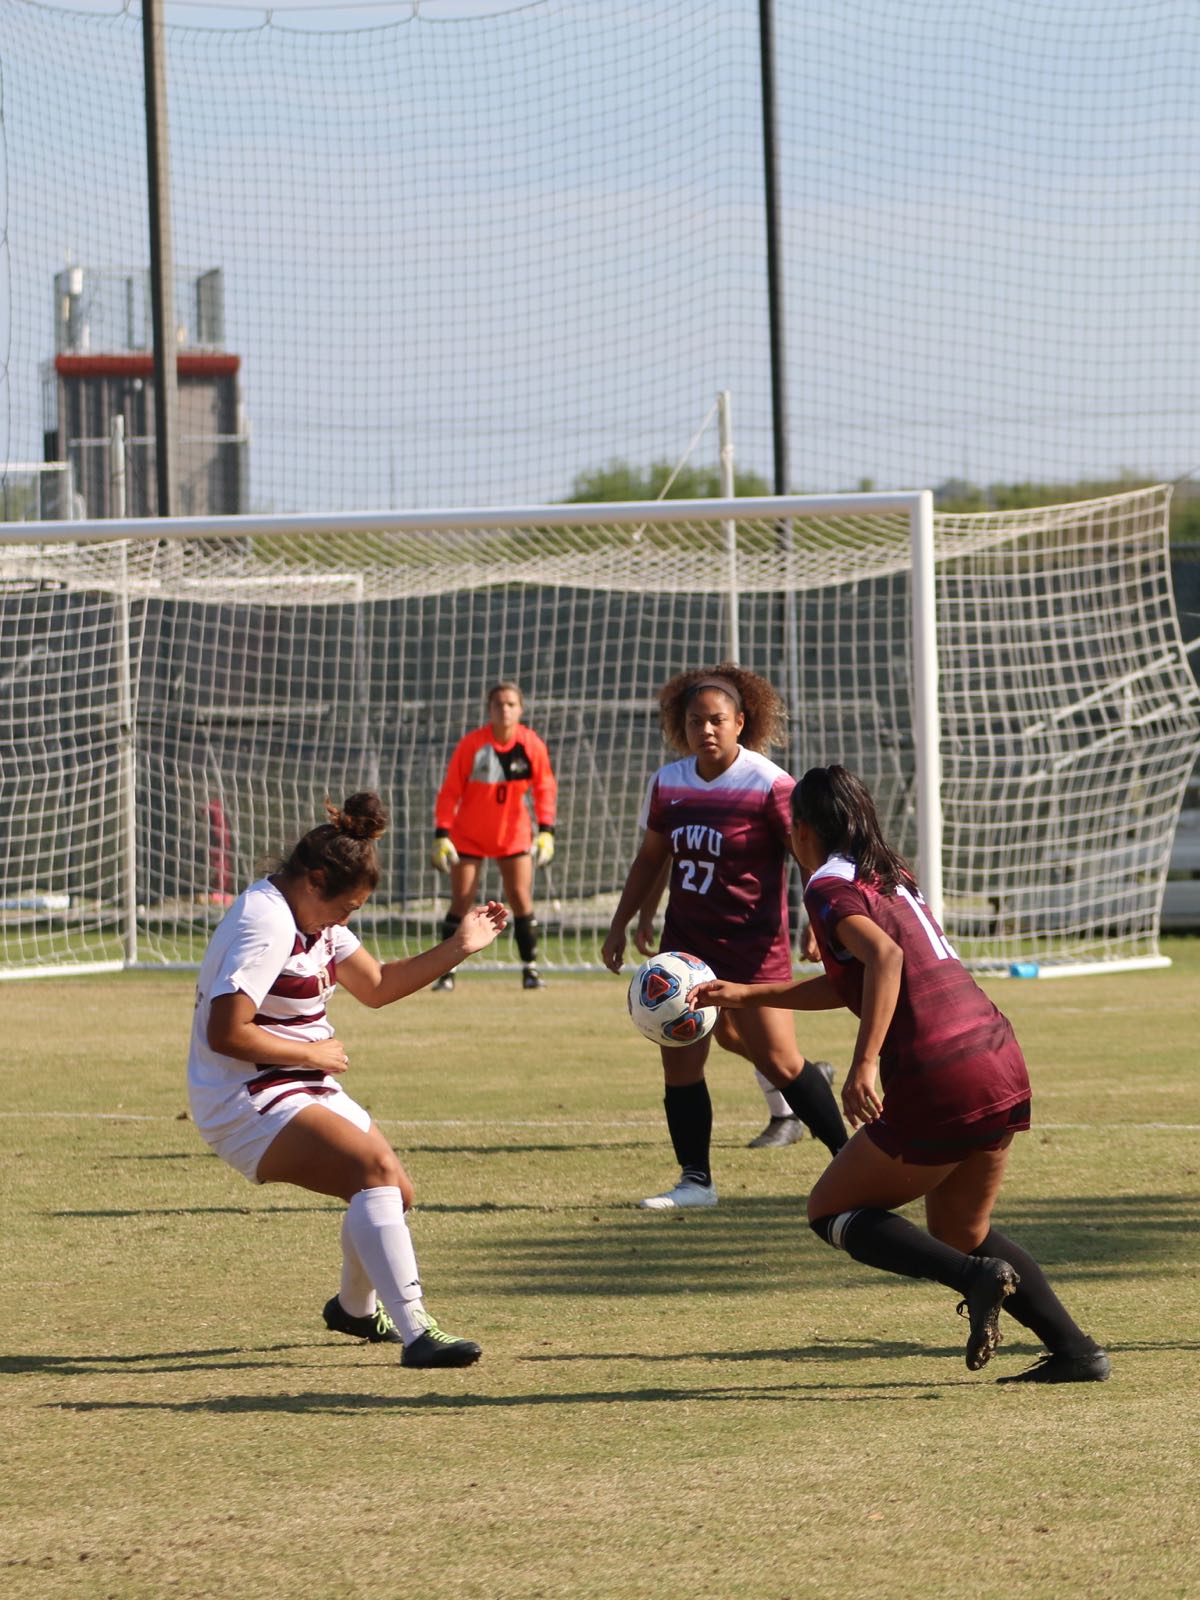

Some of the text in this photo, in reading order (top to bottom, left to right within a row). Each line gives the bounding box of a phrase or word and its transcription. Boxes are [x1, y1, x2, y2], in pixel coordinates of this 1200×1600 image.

[496, 784, 507, 804] 0
[671, 824, 724, 857] TWU
[678, 859, 715, 895] 27
